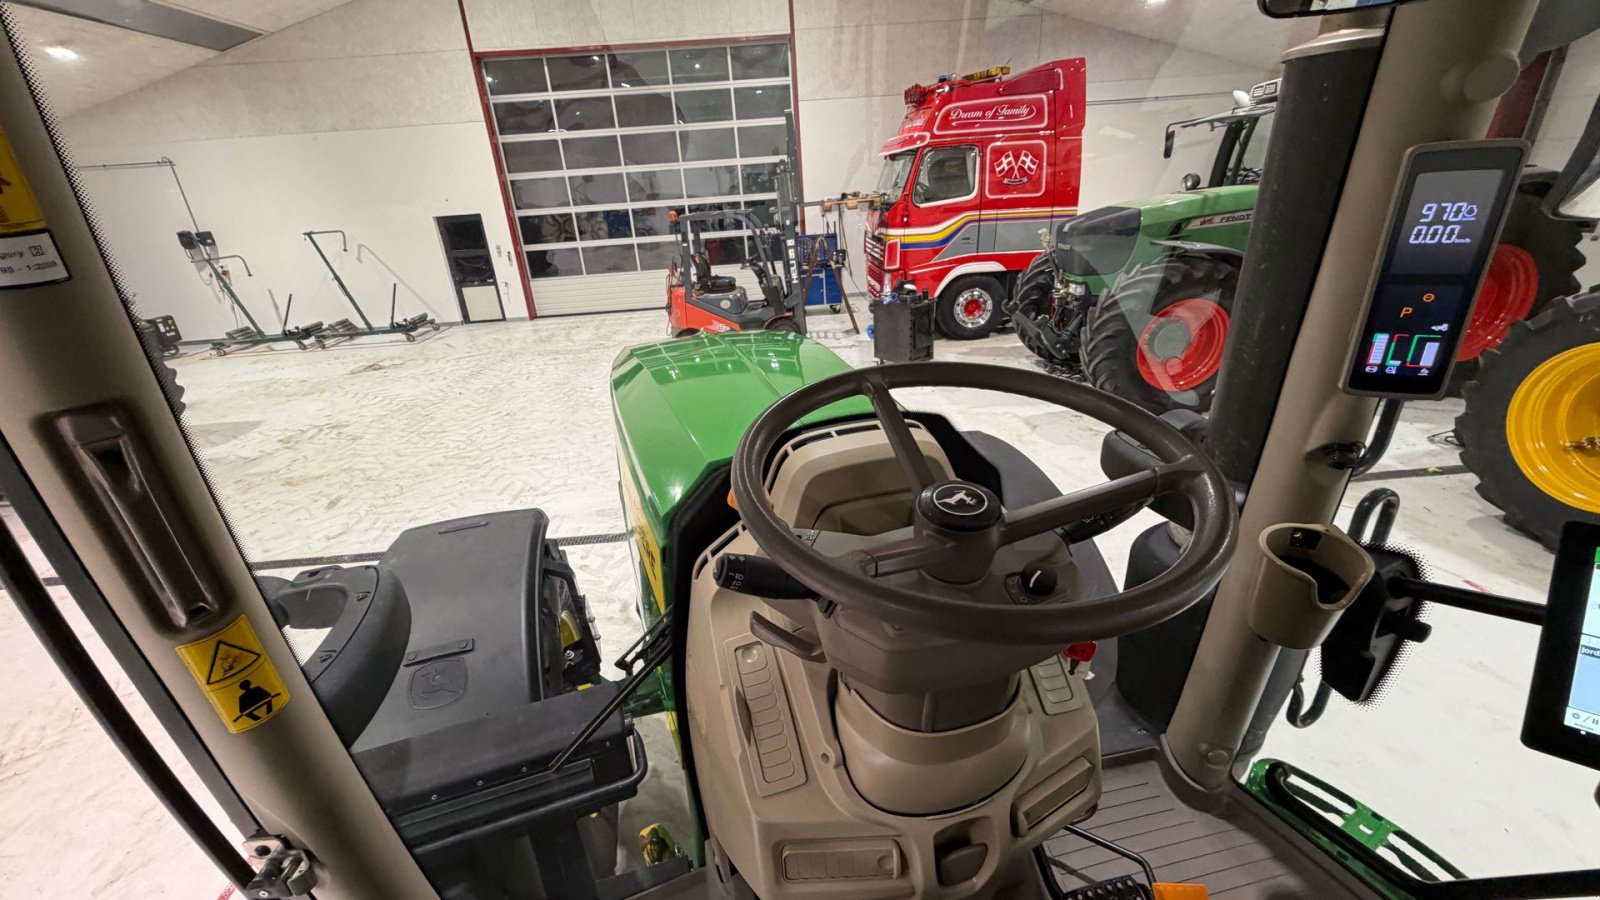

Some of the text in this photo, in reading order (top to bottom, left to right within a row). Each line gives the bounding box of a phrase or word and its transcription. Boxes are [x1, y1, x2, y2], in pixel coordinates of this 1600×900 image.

[950, 104, 1030, 119] Dream of Family
[1219, 213, 1252, 223] FENDT
[1420, 202, 1467, 222] 970
[1409, 225, 1461, 243] 0.00
[1400, 307, 1413, 318] P
